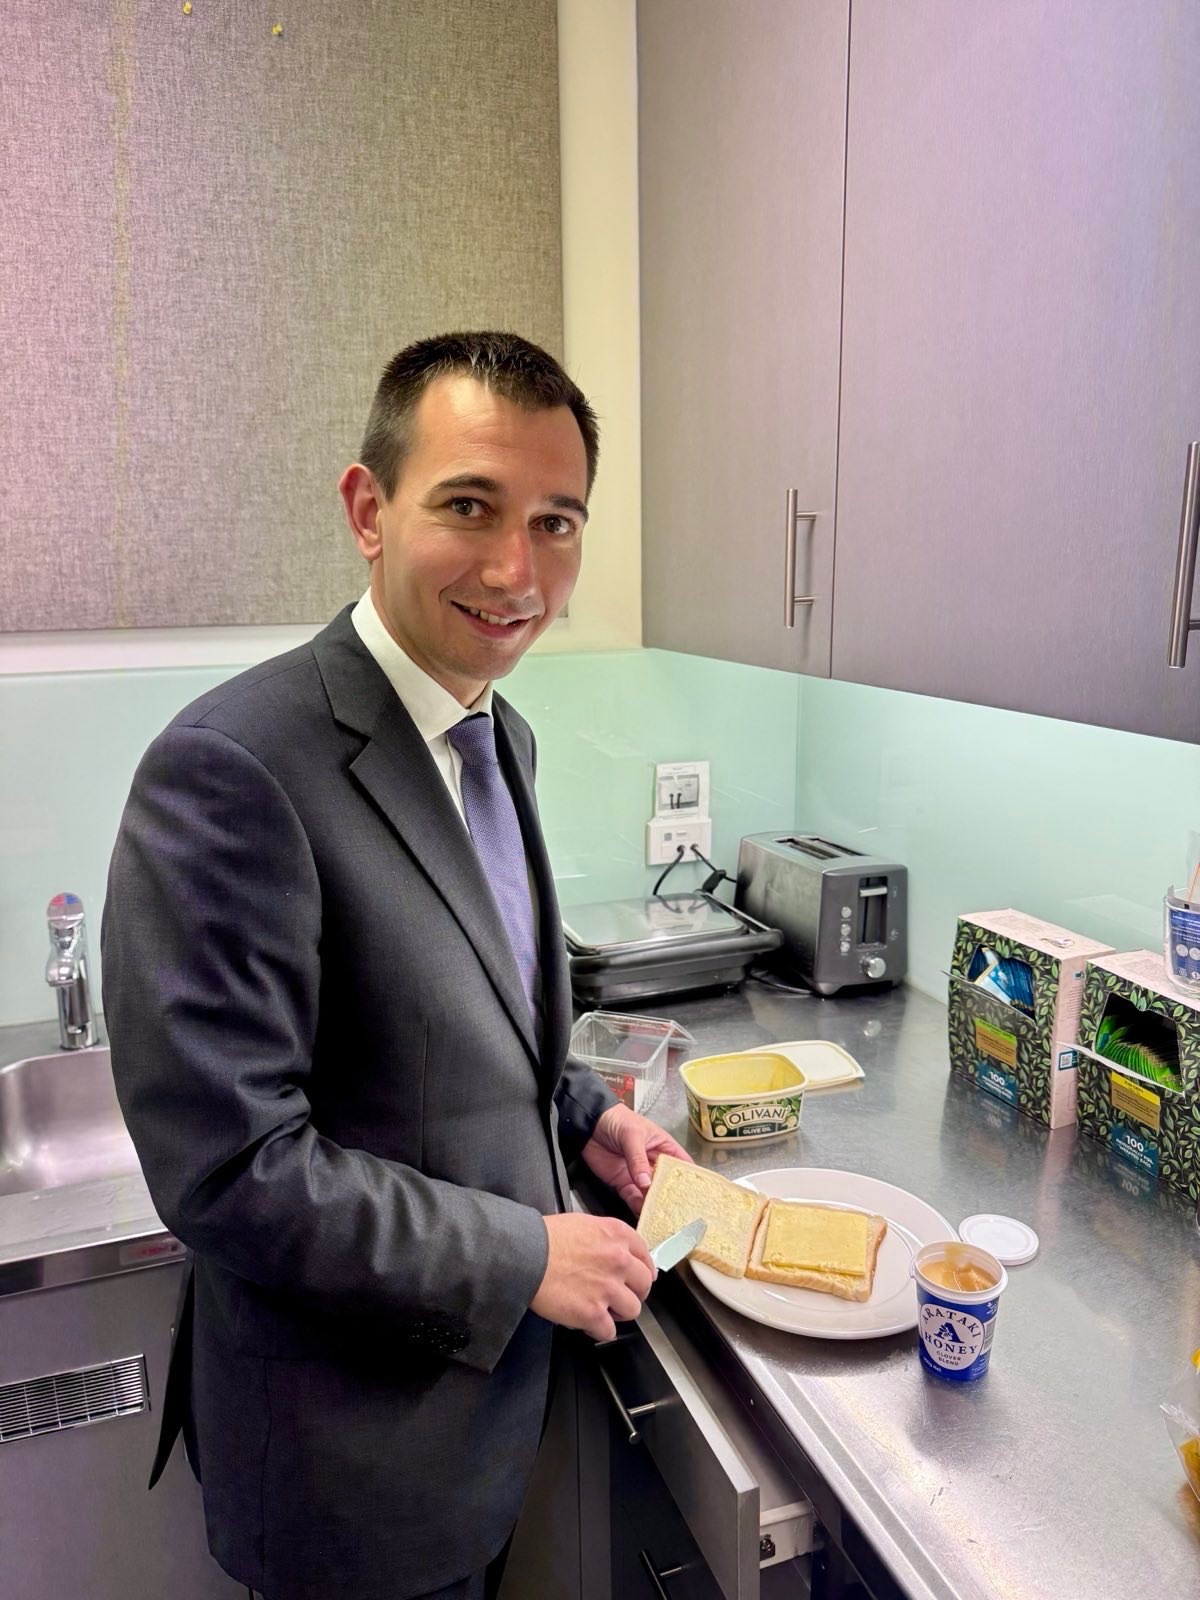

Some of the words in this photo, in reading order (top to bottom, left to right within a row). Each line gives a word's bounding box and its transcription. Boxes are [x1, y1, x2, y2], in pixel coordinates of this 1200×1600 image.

[989, 1072, 1005, 1085] 100
[729, 1108, 787, 1124] OLIVANI
[742, 1127, 761, 1135] OLIVE
[1126, 1135, 1144, 1152] 100
[922, 1307, 981, 1338] ARATAKI
[924, 1331, 977, 1355] HONEY
[936, 1350, 961, 1361] CLOVER
[938, 1356, 960, 1366] BLEND
